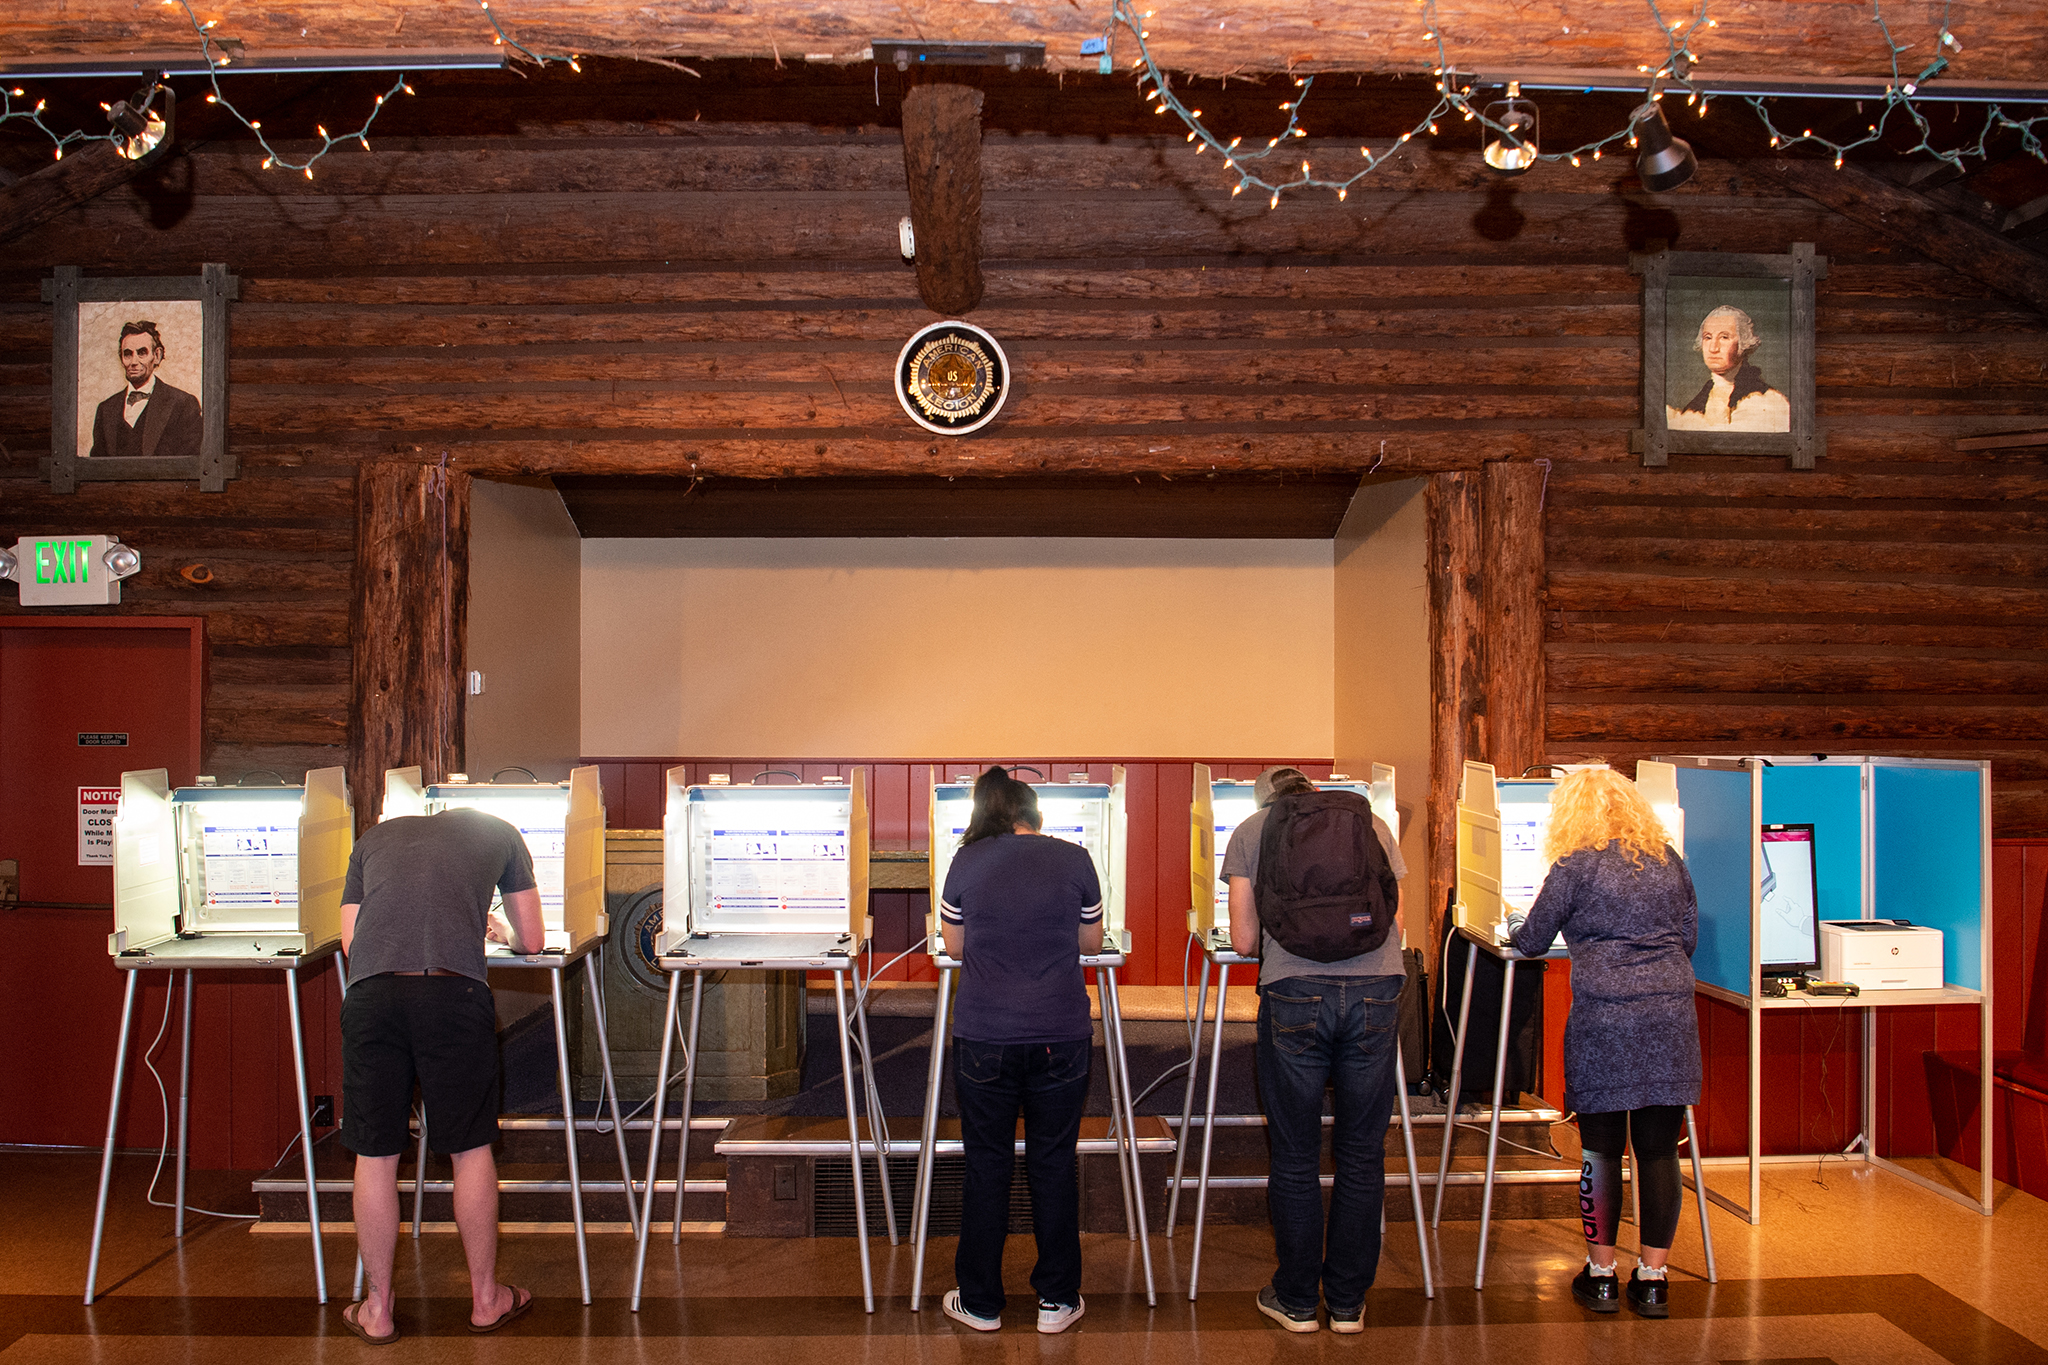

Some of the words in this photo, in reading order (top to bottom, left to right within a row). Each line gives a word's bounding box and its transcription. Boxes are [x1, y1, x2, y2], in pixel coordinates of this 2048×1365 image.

[922, 343, 984, 370] AMERICAN
[947, 370, 958, 382] US
[926, 392, 978, 411] LEGION
[35, 540, 92, 584] EXIT
[83, 790, 121, 801] NOTIC
[87, 818, 112, 826] CLOS
[96, 839, 113, 847] Play
